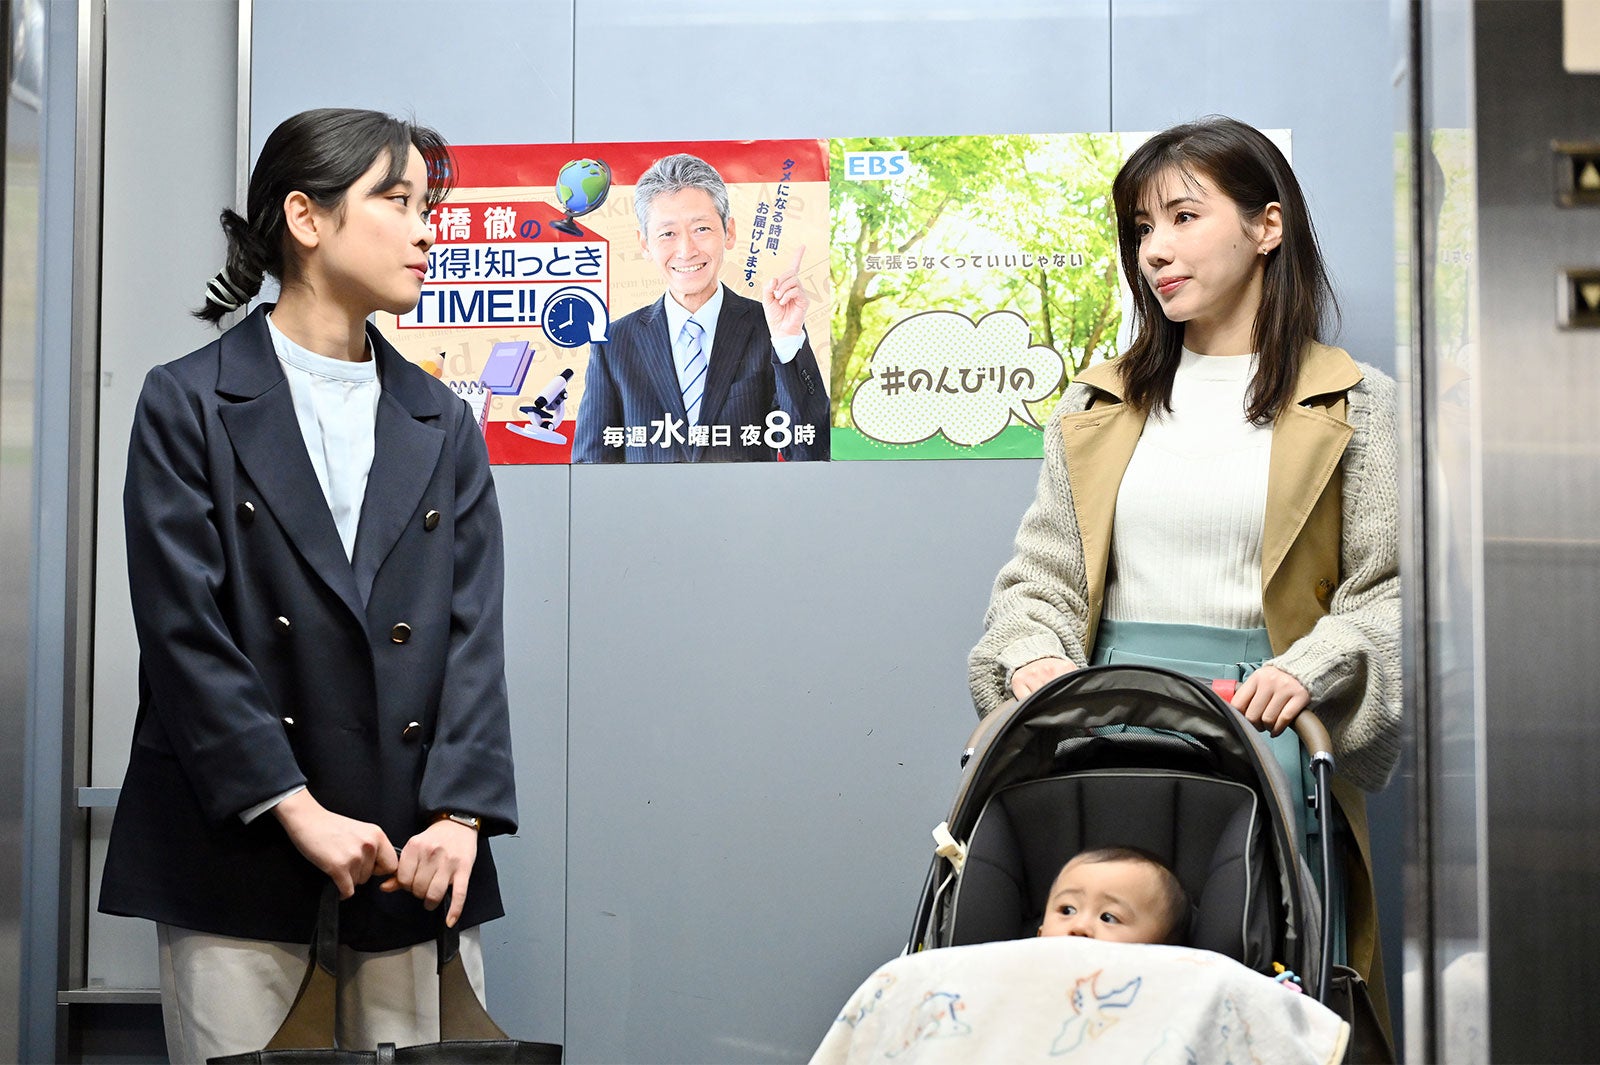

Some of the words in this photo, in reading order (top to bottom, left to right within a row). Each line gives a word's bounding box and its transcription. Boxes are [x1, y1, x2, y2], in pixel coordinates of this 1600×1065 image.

[849, 155, 905, 176] EBS
[764, 158, 796, 257] タメになる時間、
[743, 201, 770, 288] お届けします。
[427, 246, 602, 280] 得!知っとき
[865, 253, 1084, 270] 気張らなくっていいじゃない
[416, 290, 535, 323] TIME!!
[880, 365, 1035, 396] #のんびりの
